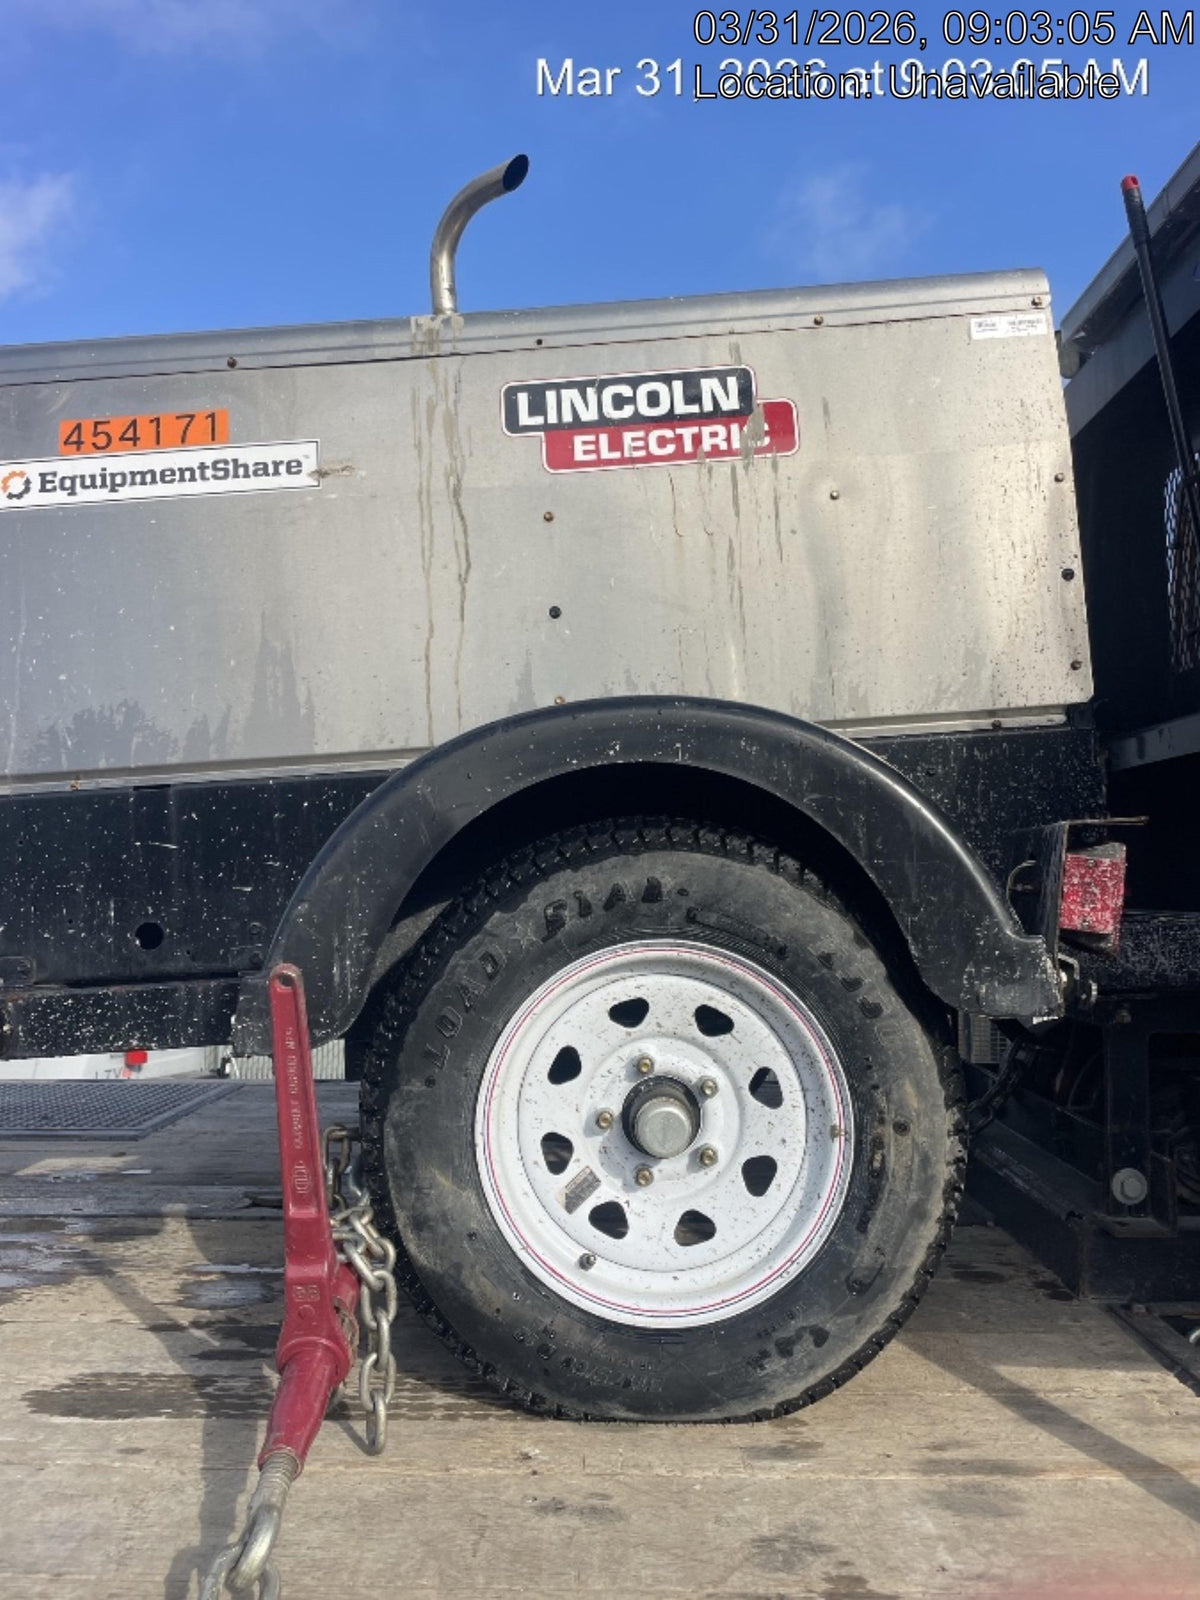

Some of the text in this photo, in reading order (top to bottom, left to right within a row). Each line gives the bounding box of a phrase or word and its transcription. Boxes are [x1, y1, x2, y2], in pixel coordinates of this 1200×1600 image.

[515, 376, 741, 427] LINCOLN
[63, 411, 217, 452] 454171
[38, 457, 303, 497] EquipmentShare
